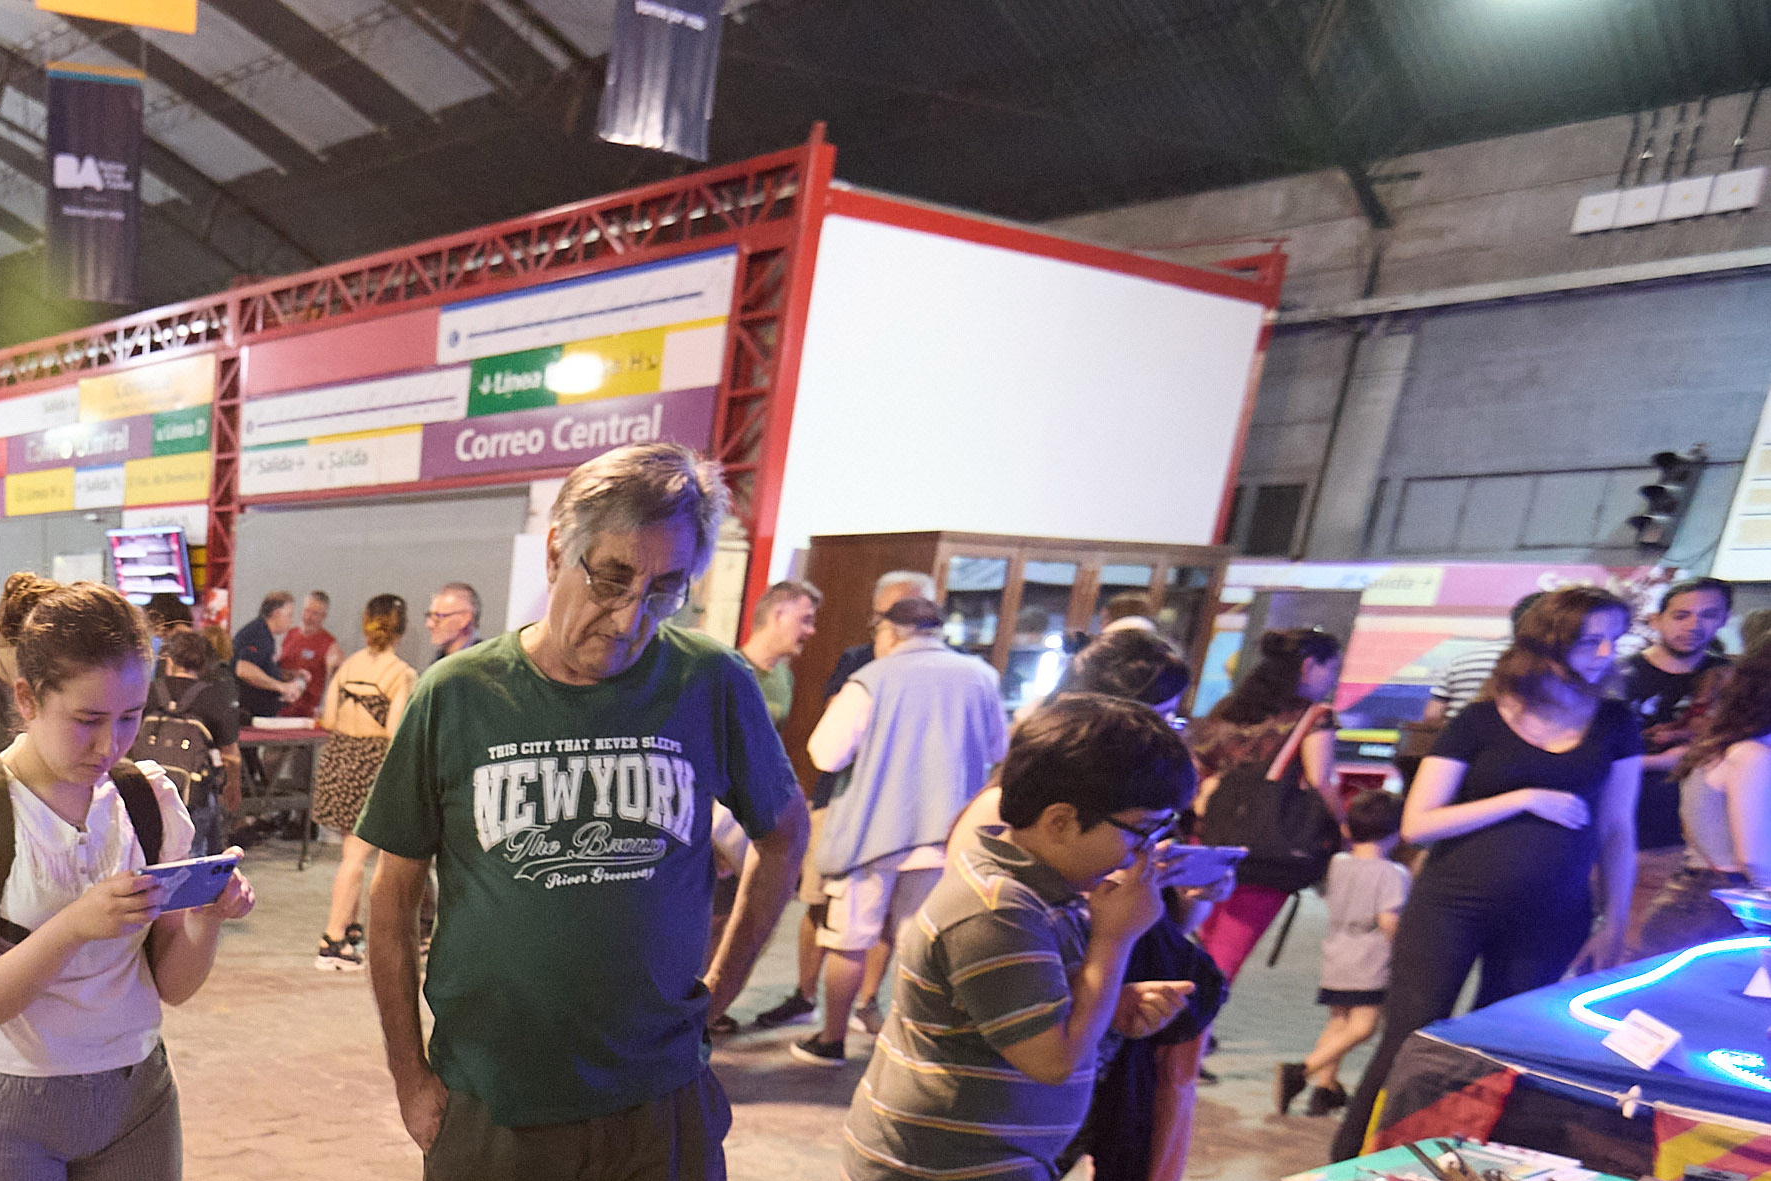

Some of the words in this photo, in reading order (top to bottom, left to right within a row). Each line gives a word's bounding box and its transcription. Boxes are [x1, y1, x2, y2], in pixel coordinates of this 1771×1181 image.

[455, 427, 545, 463] Correo
[552, 404, 663, 449] Central
[488, 743, 518, 760] THIS
[520, 740, 551, 755] CITY
[554, 738, 590, 753] THAT
[594, 736, 639, 751] NEVER
[642, 736, 683, 754] SLEEPS
[544, 870, 588, 890] River
